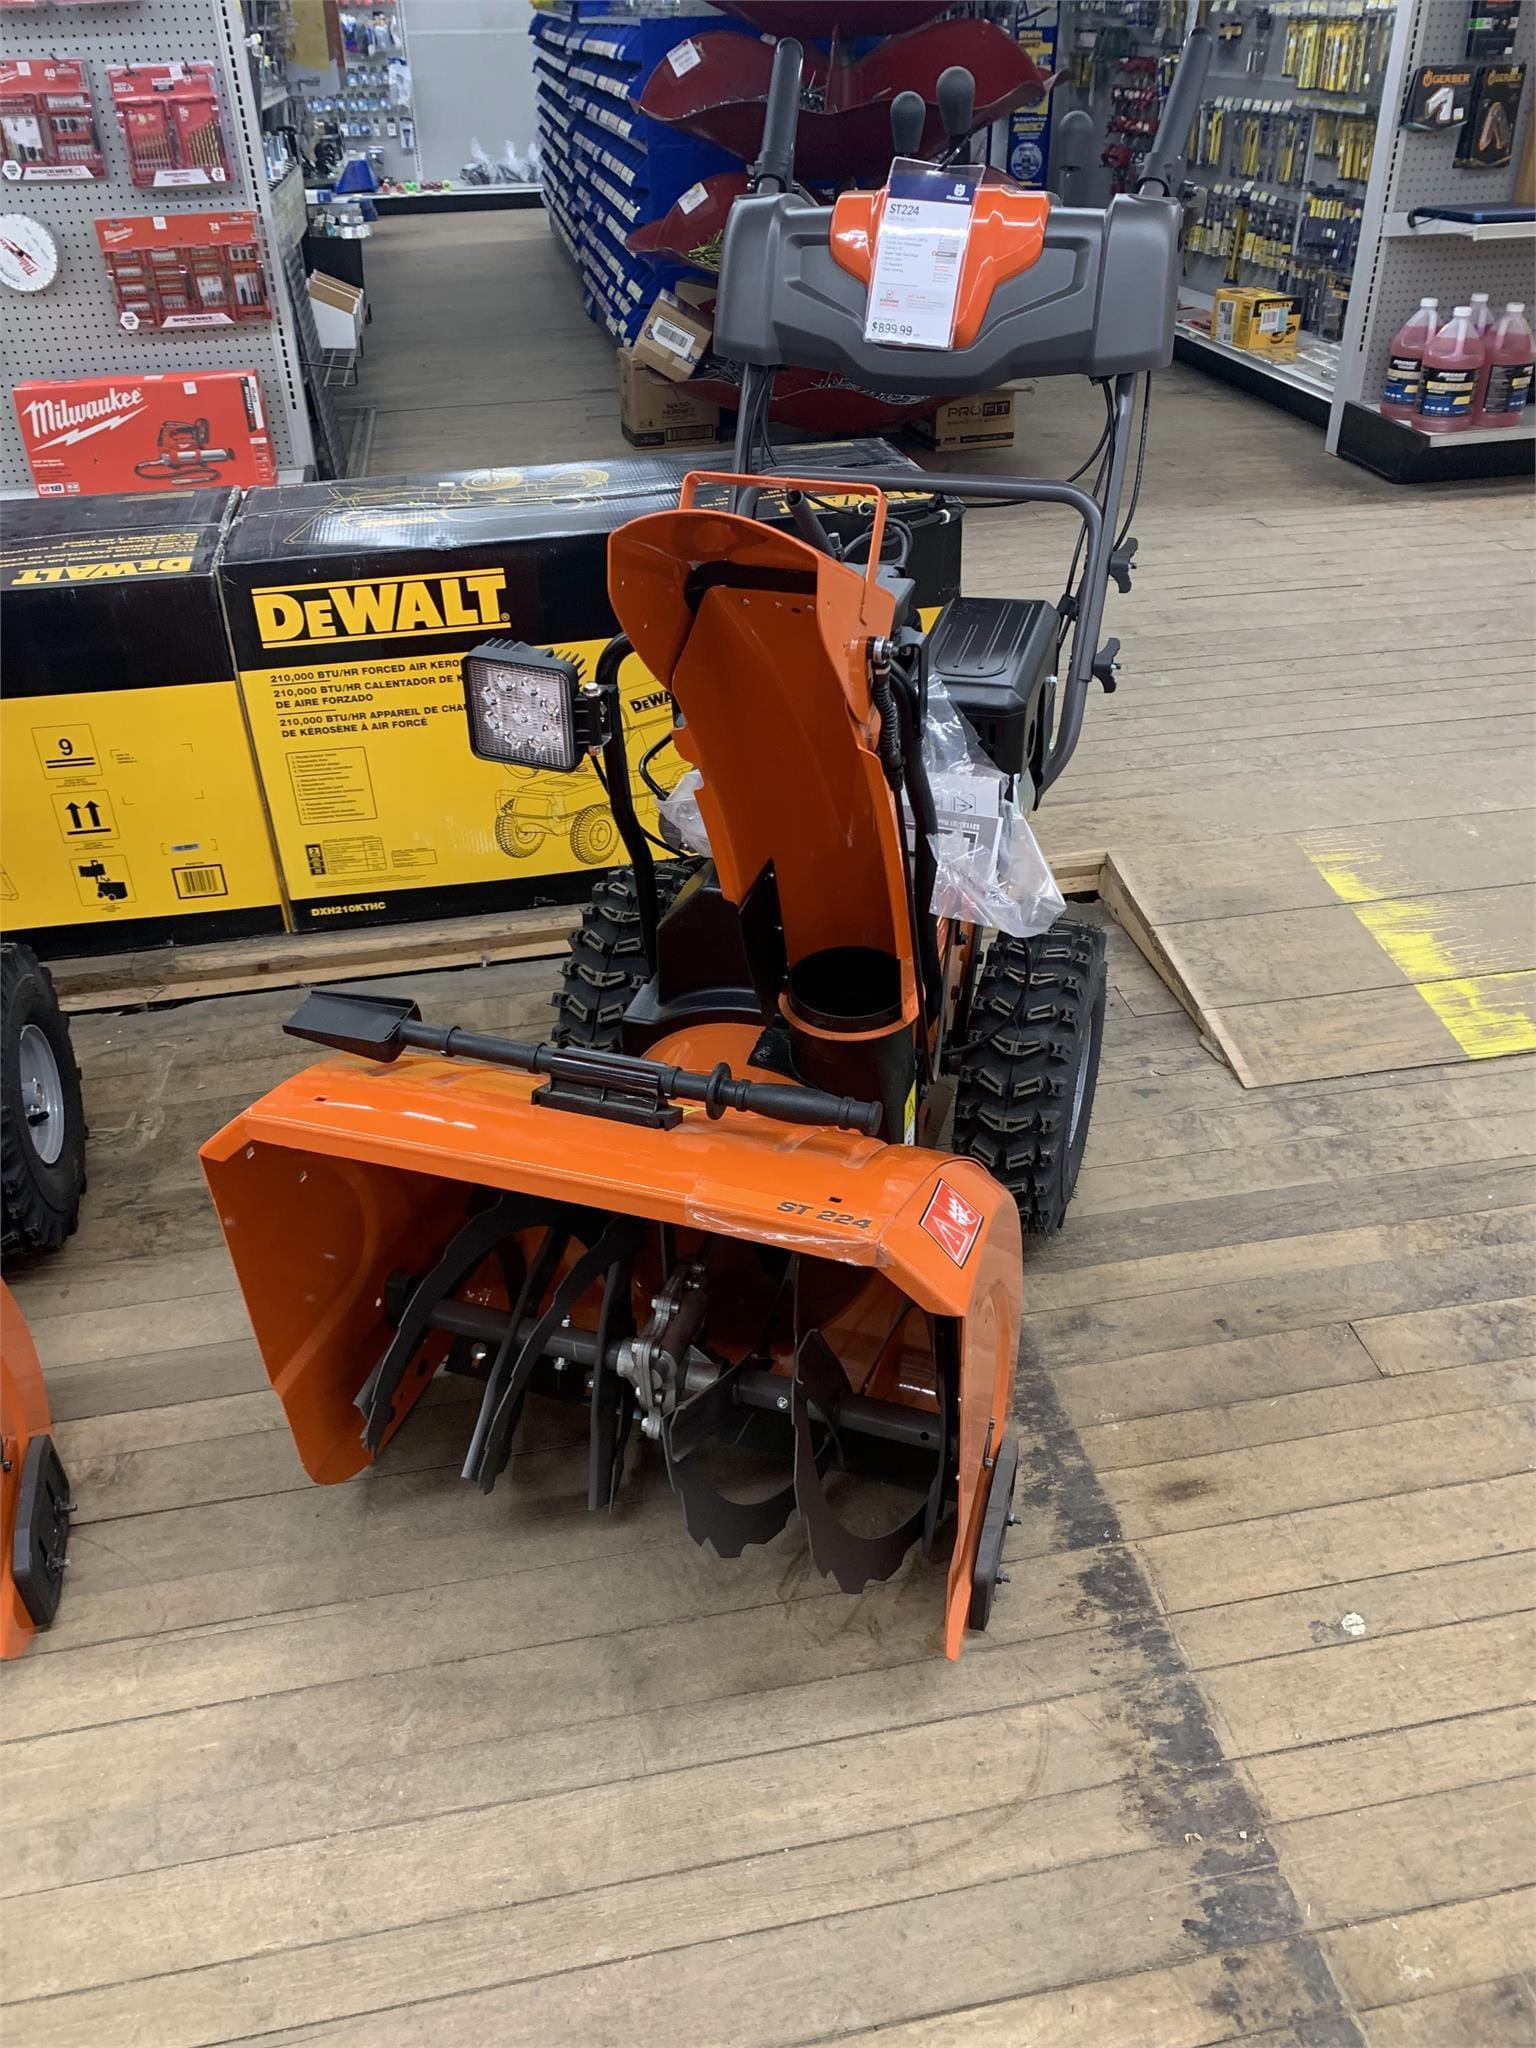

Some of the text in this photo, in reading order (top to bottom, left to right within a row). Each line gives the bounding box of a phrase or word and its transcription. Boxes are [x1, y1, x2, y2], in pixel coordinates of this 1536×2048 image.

[889, 203, 920, 216] ST224
[872, 321, 913, 336] $899.99
[21, 387, 144, 438] Milwaukee
[252, 574, 507, 642] DEWALT
[270, 659, 461, 683] 210,000 BTU/HR FORCED AIR KERO
[273, 687, 317, 698] 210,000
[320, 683, 362, 694] BTU/HR
[364, 676, 436, 689] CALENTADOR
[438, 675, 454, 683] DE
[275, 694, 374, 709] DE AIRE FORZADO
[279, 716, 323, 727] 210,000
[325, 712, 367, 723] BTU/HR
[370, 708, 421, 719] APPAREIL
[423, 705, 439, 715] DE
[281, 729, 297, 738] DE
[361, 722, 369, 731] À
[371, 721, 389, 730] AIR
[392, 717, 428, 728] FORCÉ
[57, 738, 74, 757] 9
[310, 901, 387, 917] DXH210KTHC
[776, 1200, 873, 1229] ST 224
